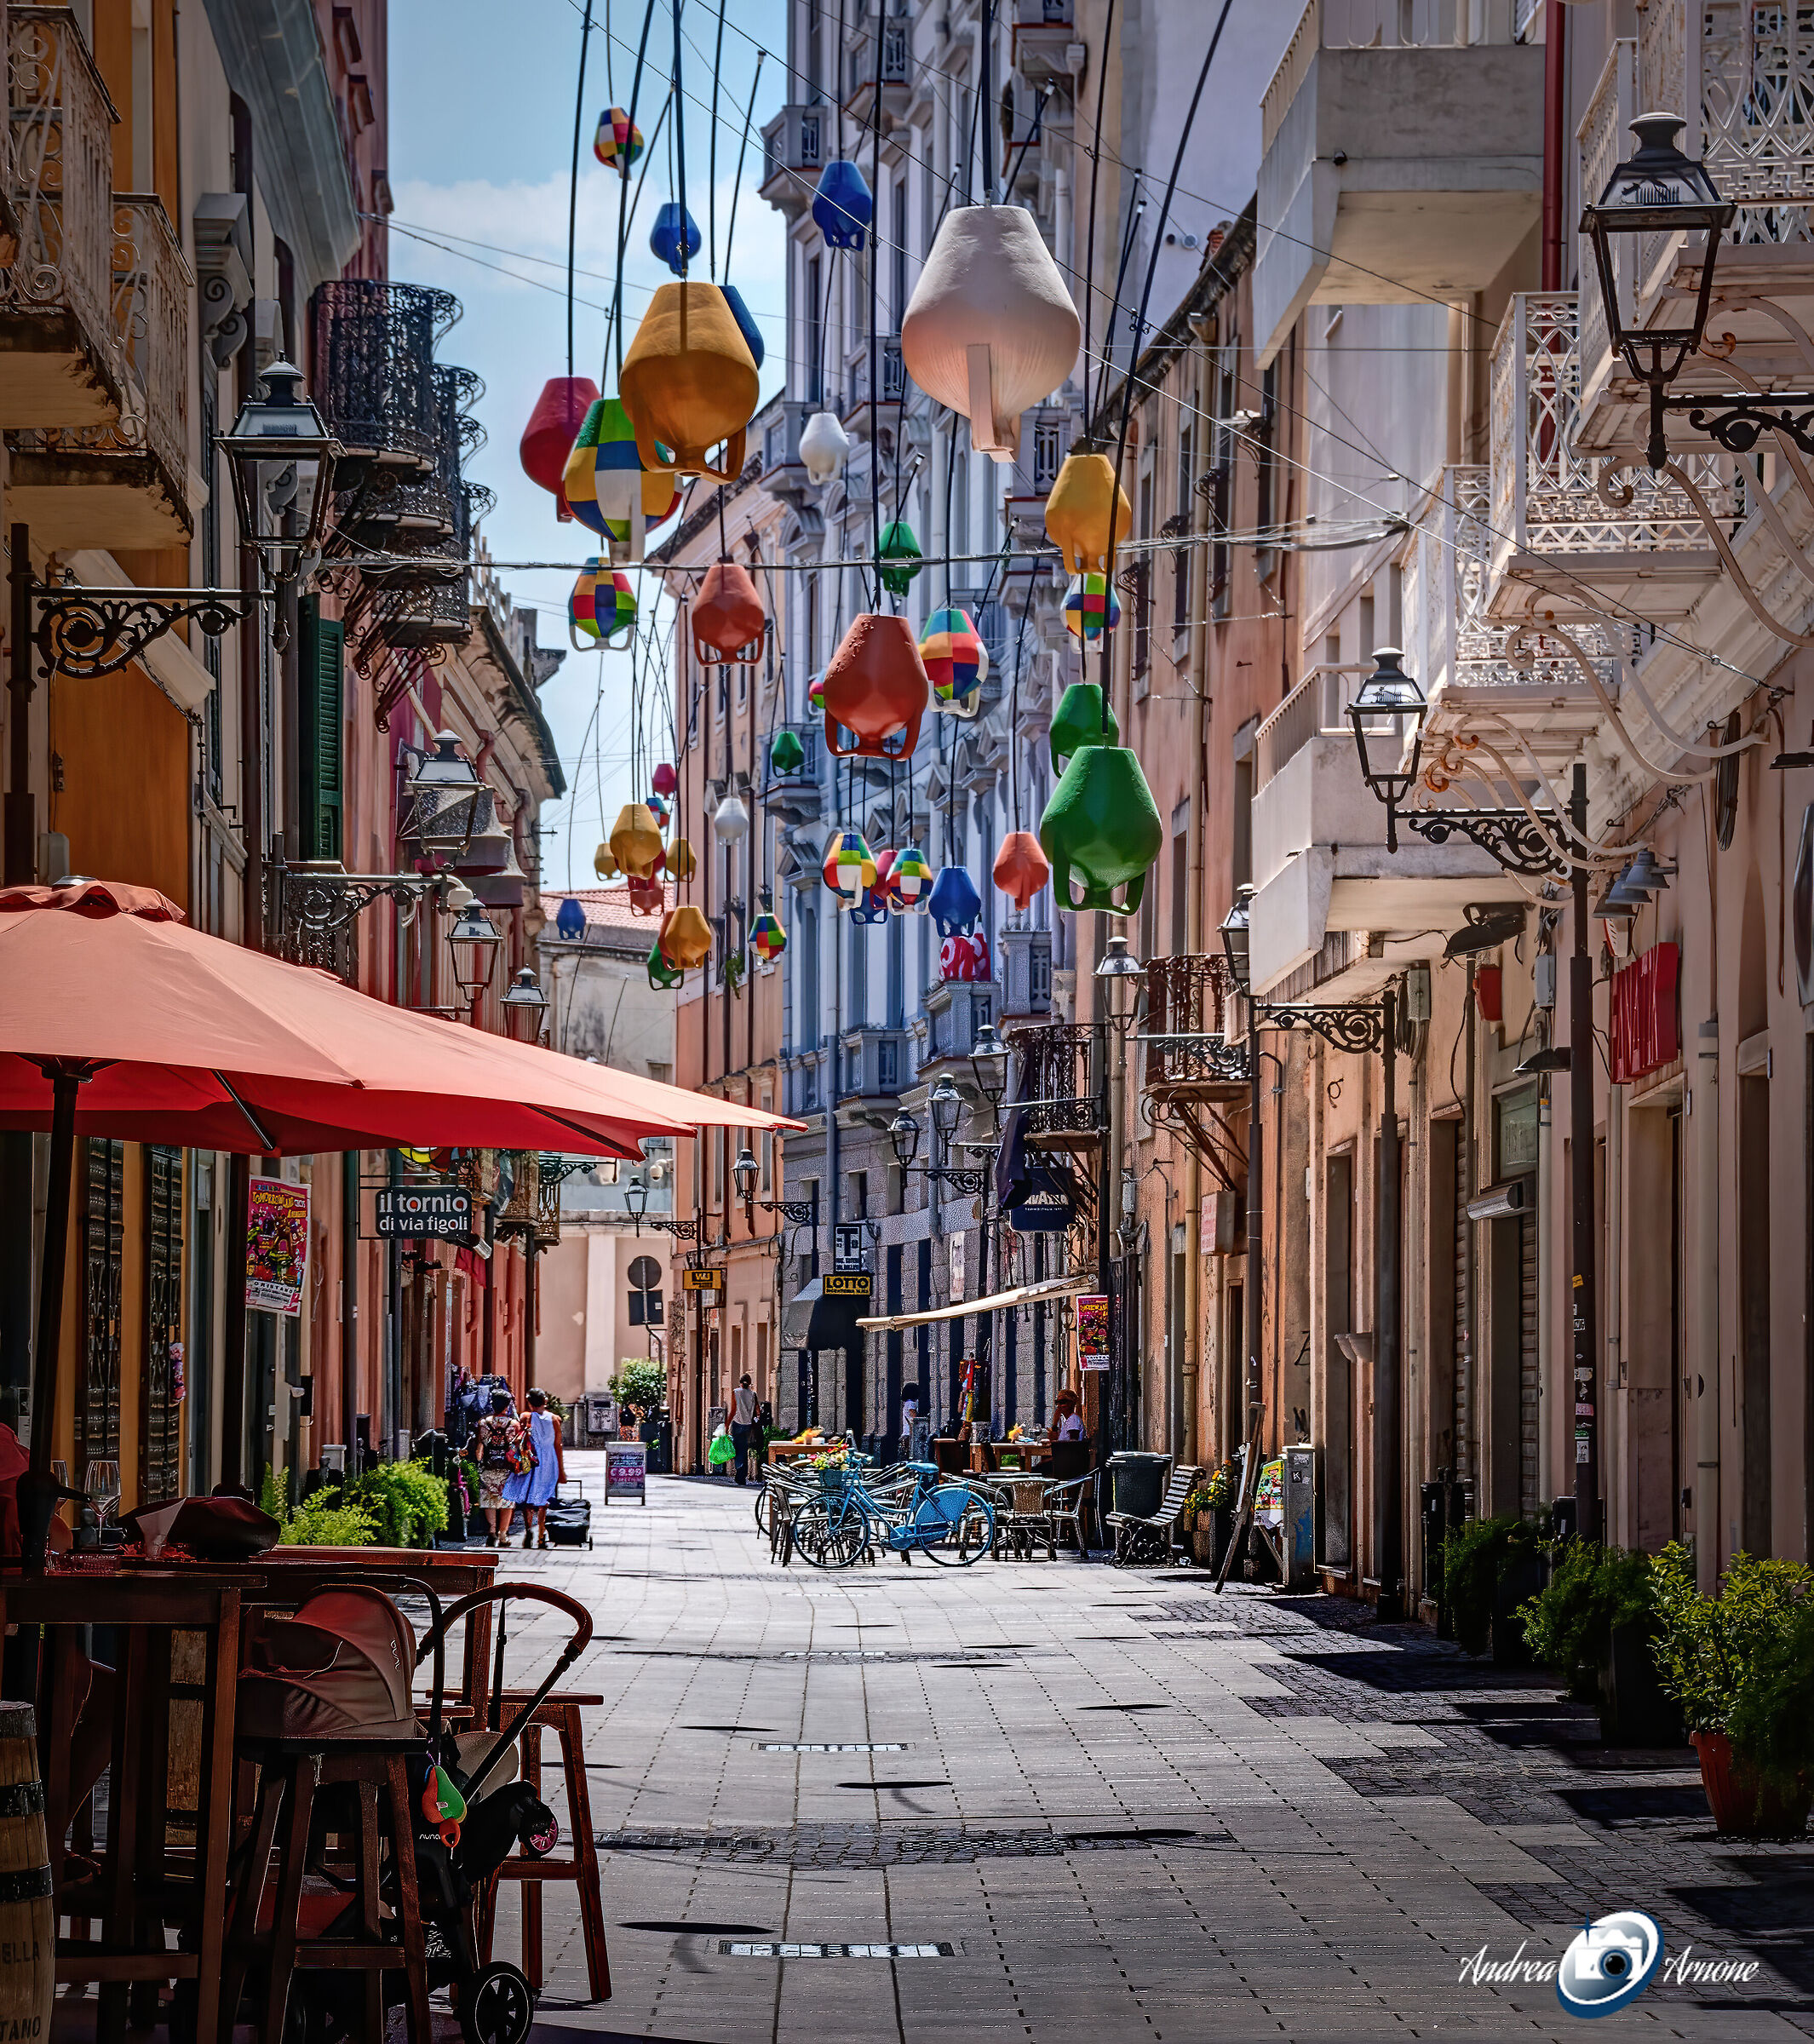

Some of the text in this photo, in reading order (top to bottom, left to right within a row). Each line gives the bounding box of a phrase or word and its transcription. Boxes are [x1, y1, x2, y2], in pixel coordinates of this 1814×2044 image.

[379, 1192, 468, 1213] il tornio
[379, 1216, 468, 1233] di via figoli
[826, 1278, 869, 1289] LOTTO
